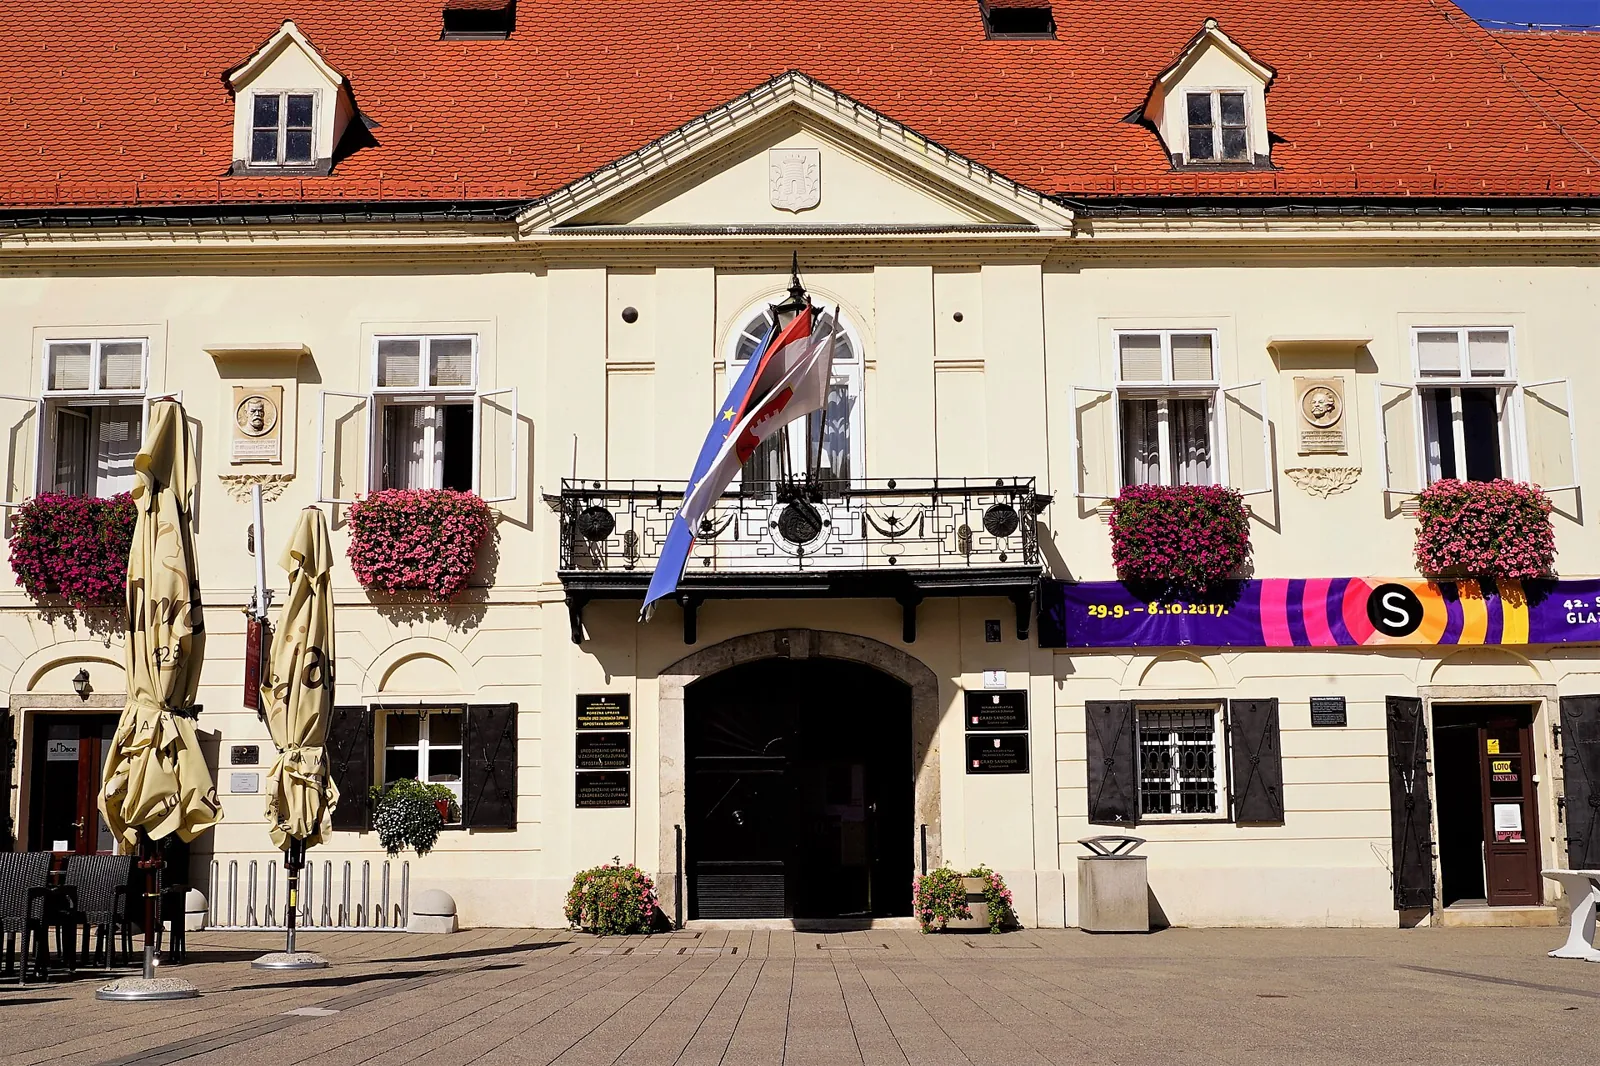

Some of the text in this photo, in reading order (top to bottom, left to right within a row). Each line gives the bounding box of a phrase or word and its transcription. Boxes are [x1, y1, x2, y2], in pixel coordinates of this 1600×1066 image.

[1088, 604, 1130, 618] 29.9.
[1147, 601, 1229, 617] 8.10.2017.
[1382, 592, 1409, 627] S
[1563, 599, 1589, 611] 42.
[1494, 763, 1509, 771] LOTO
